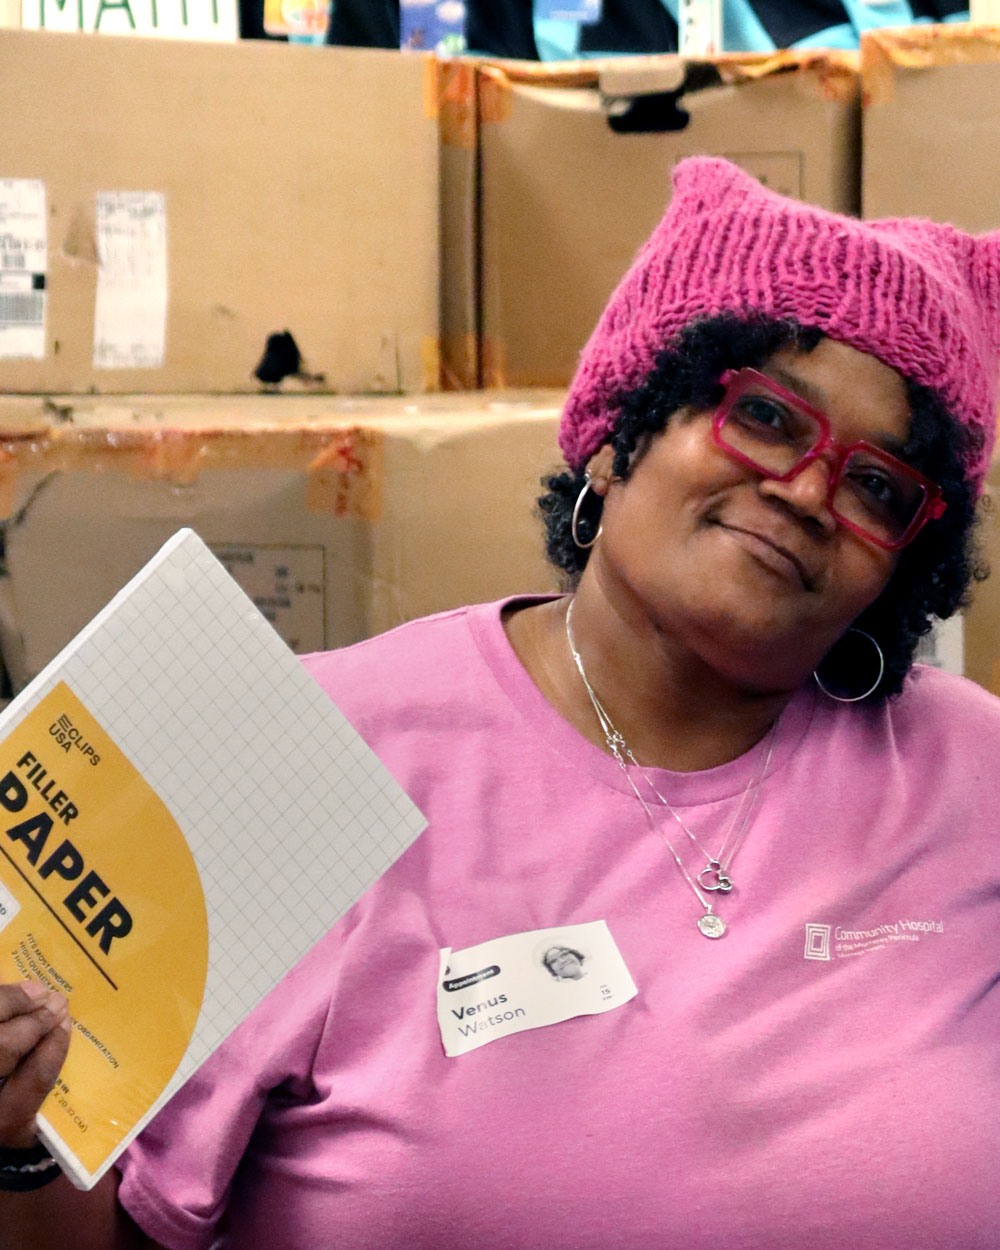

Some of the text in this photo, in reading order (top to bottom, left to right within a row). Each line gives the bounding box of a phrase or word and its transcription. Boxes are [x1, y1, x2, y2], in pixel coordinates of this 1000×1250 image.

[49, 723, 73, 752] USA
[16, 751, 79, 826] FILLER
[835, 920, 944, 941] Community Hospital
[19, 941, 31, 960] HIGH
[29, 961, 51, 985] QUALITY
[26, 933, 37, 949] FITS
[35, 949, 50, 968] MOST
[48, 967, 73, 992] BINDERS
[451, 994, 508, 1020] Venus
[458, 1008, 526, 1037] Watson
[77, 1024, 119, 1069] ORGANIZATION
